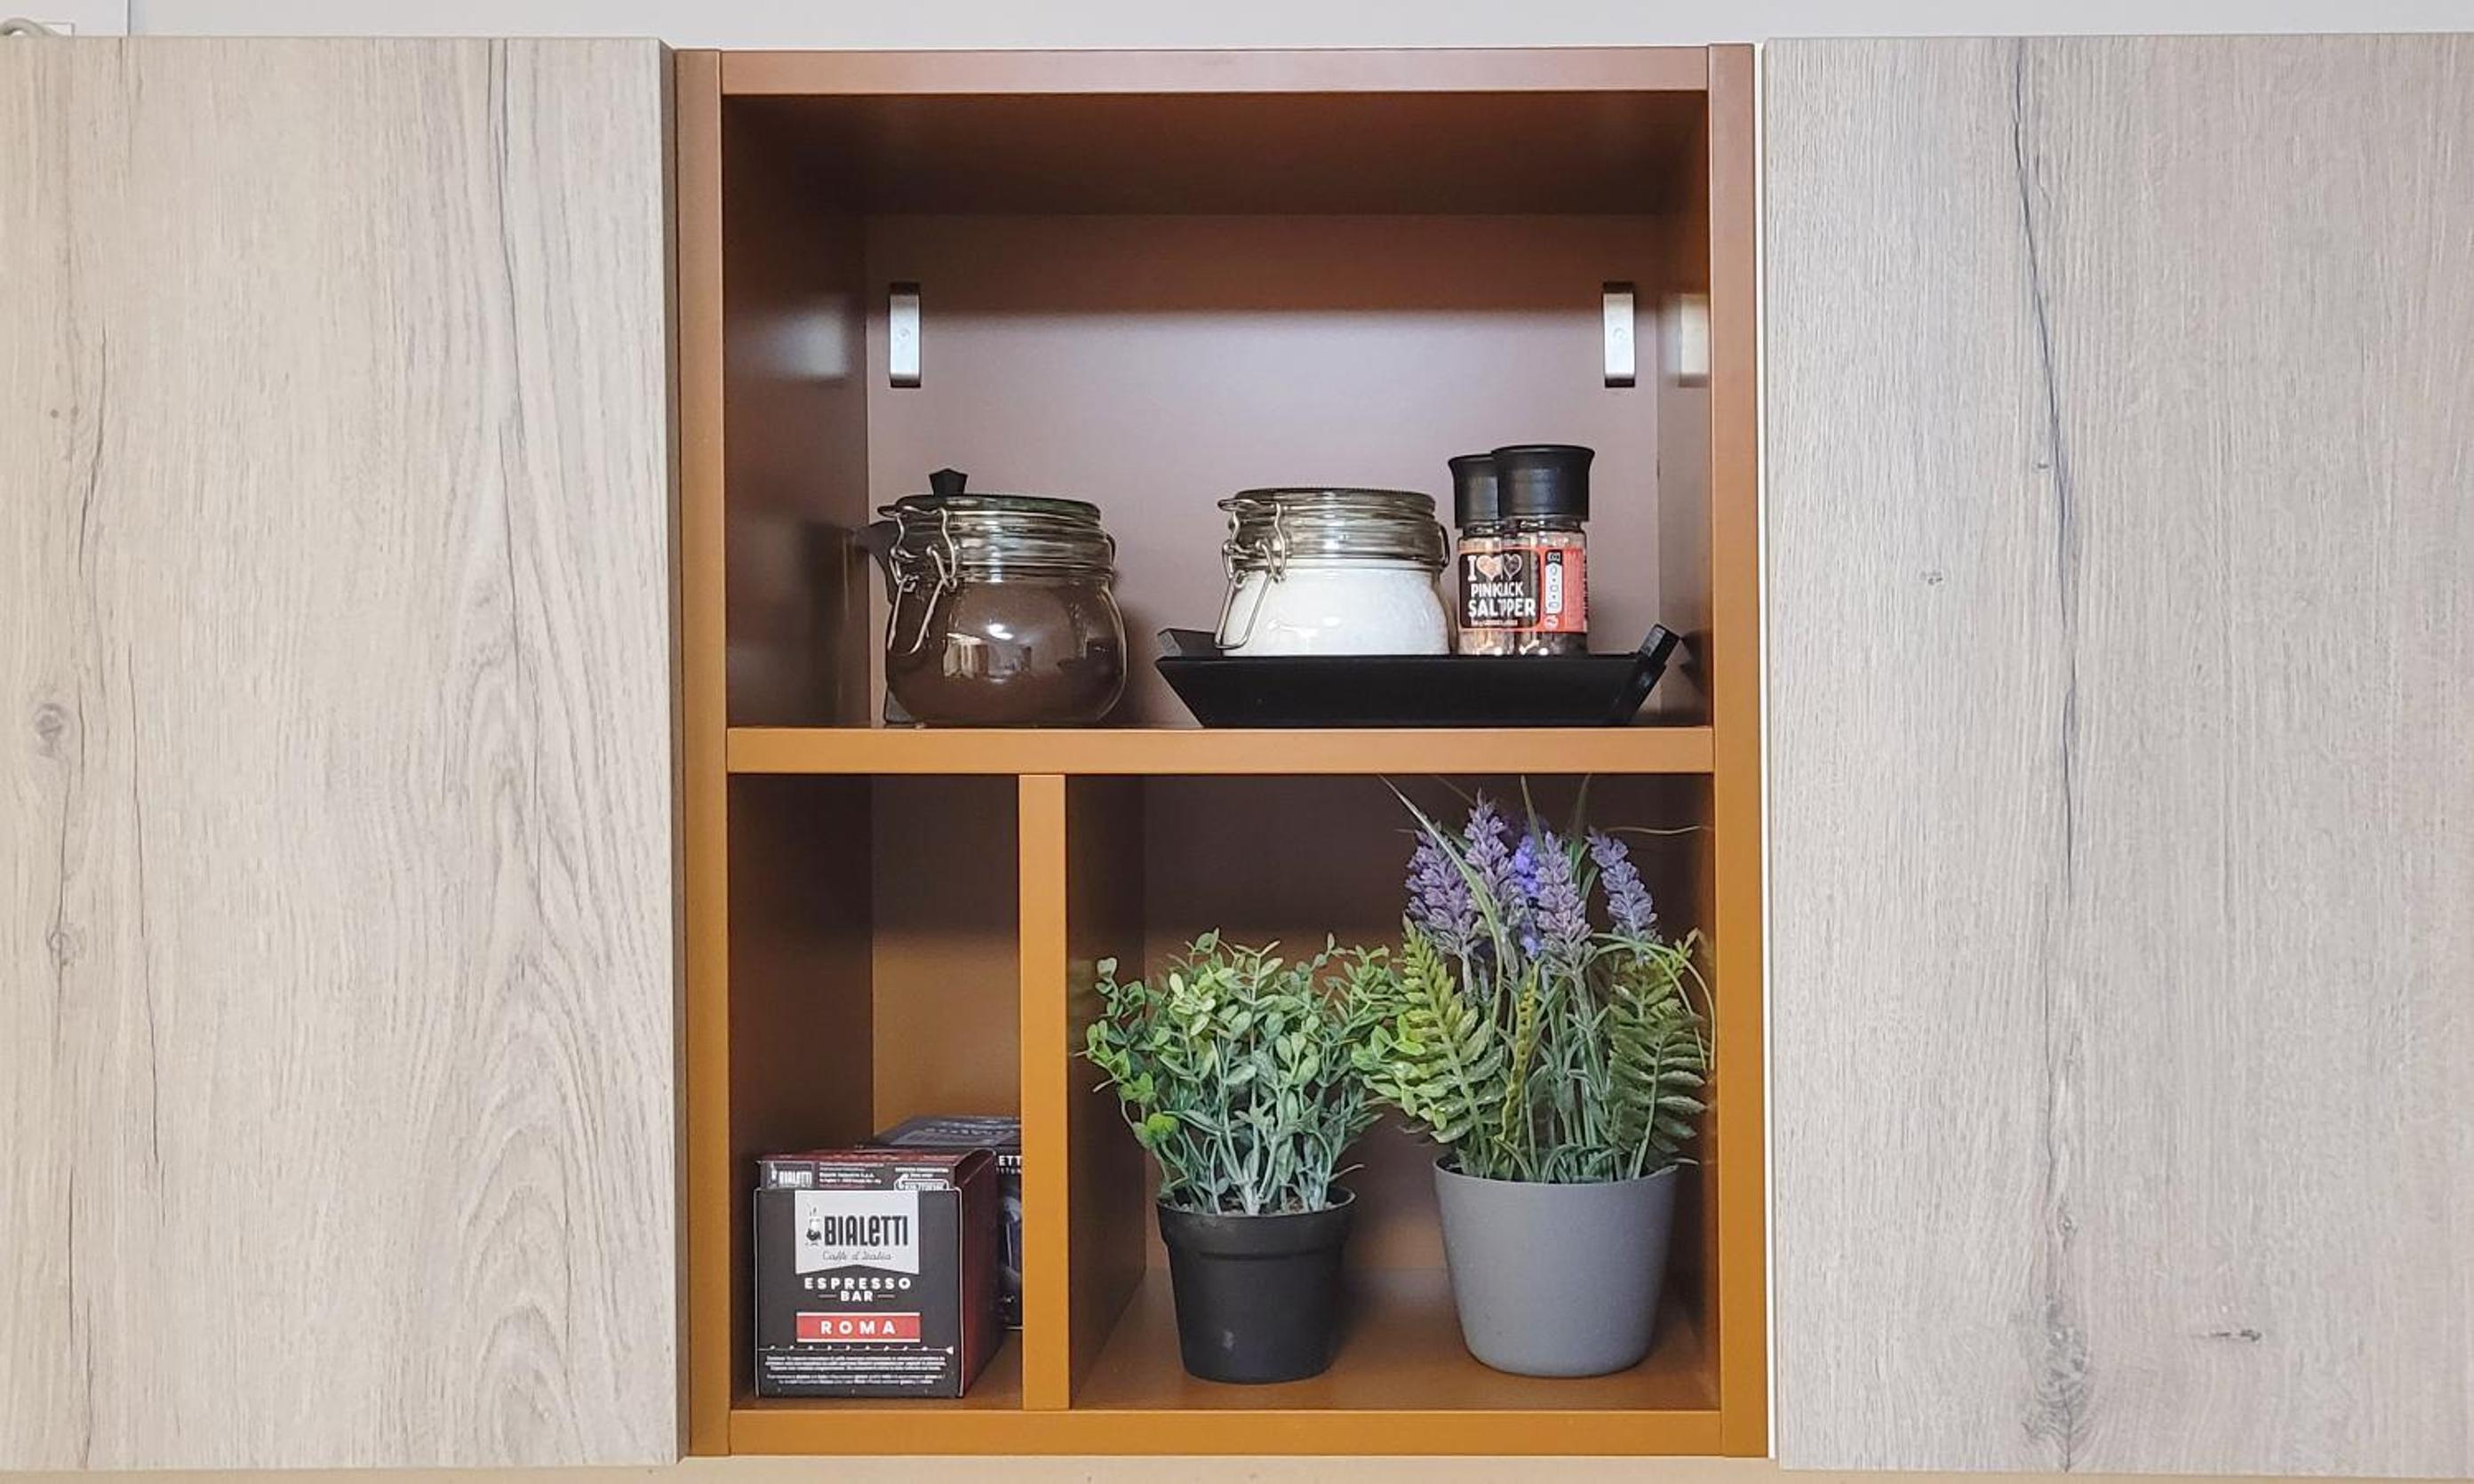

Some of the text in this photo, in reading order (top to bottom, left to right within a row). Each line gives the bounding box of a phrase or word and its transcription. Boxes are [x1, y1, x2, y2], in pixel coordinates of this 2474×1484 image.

[804, 1277, 911, 1290] ESPRESSO
[840, 1290, 874, 1302] BAR
[820, 1320, 896, 1335] ROMA
